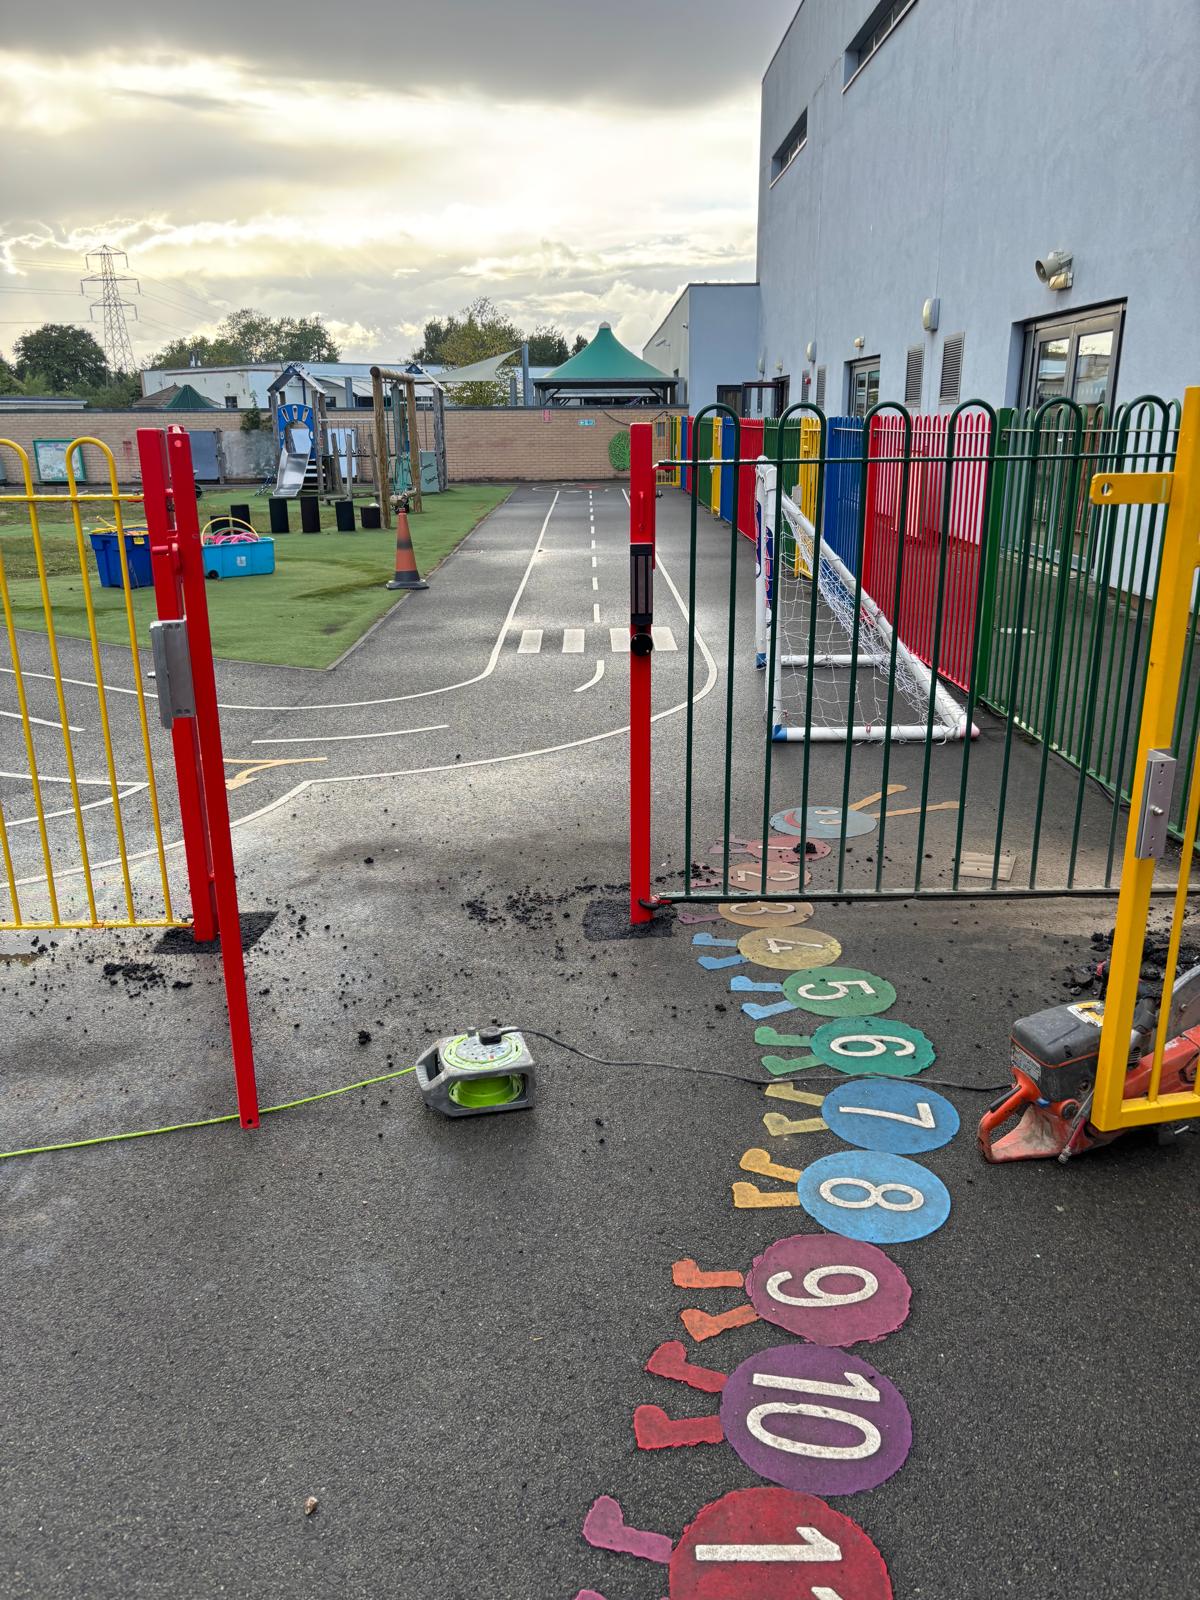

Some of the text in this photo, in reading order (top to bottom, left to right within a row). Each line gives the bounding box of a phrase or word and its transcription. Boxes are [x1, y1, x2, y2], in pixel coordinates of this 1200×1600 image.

[737, 870, 799, 882] 2
[730, 902, 796, 916] 3
[766, 938, 824, 954] 4
[797, 980, 876, 1001] 5
[830, 1034, 916, 1057] 6
[839, 1102, 936, 1129] 7
[819, 1177, 925, 1212] 8
[766, 1265, 879, 1307] 9
[746, 1371, 882, 1460] 10
[695, 1526, 844, 1600] 1
